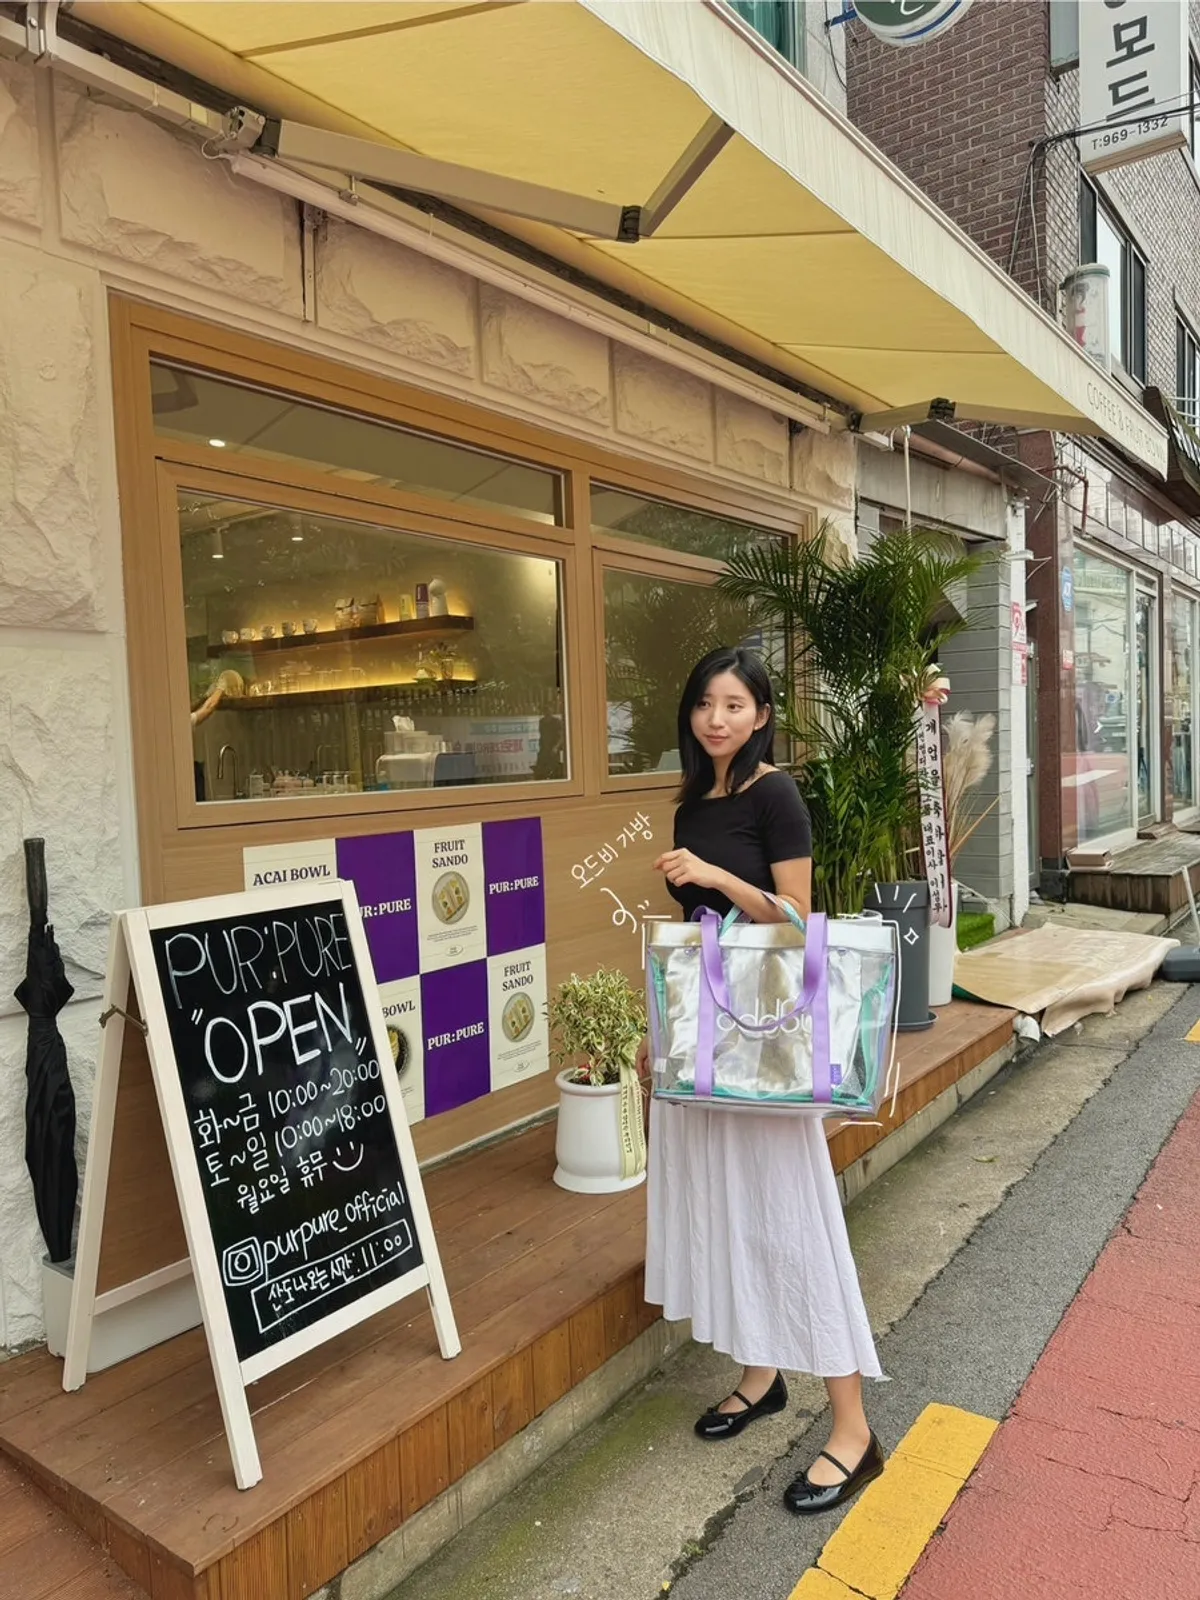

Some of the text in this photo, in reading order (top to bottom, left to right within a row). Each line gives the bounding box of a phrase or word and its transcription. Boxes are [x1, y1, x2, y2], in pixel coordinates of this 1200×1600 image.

[1104, 0, 1156, 122] 모드
[433, 839, 466, 854] FRUIT
[431, 854, 469, 868] SANDO
[253, 864, 331, 886] ACAI BOWL
[488, 875, 540, 895] PUR:PURE
[359, 898, 412, 920] R:PURE
[163, 912, 353, 1010] PUR:PURE
[503, 960, 532, 977] FRUIT
[501, 974, 534, 992] SANDO
[427, 1023, 486, 1051] PUR:PURE
[268, 1058, 381, 1119] 10:00~20:00
[274, 1094, 386, 1157] 10:00~18:00
[236, 1149, 327, 1216] 월요일 휴무
